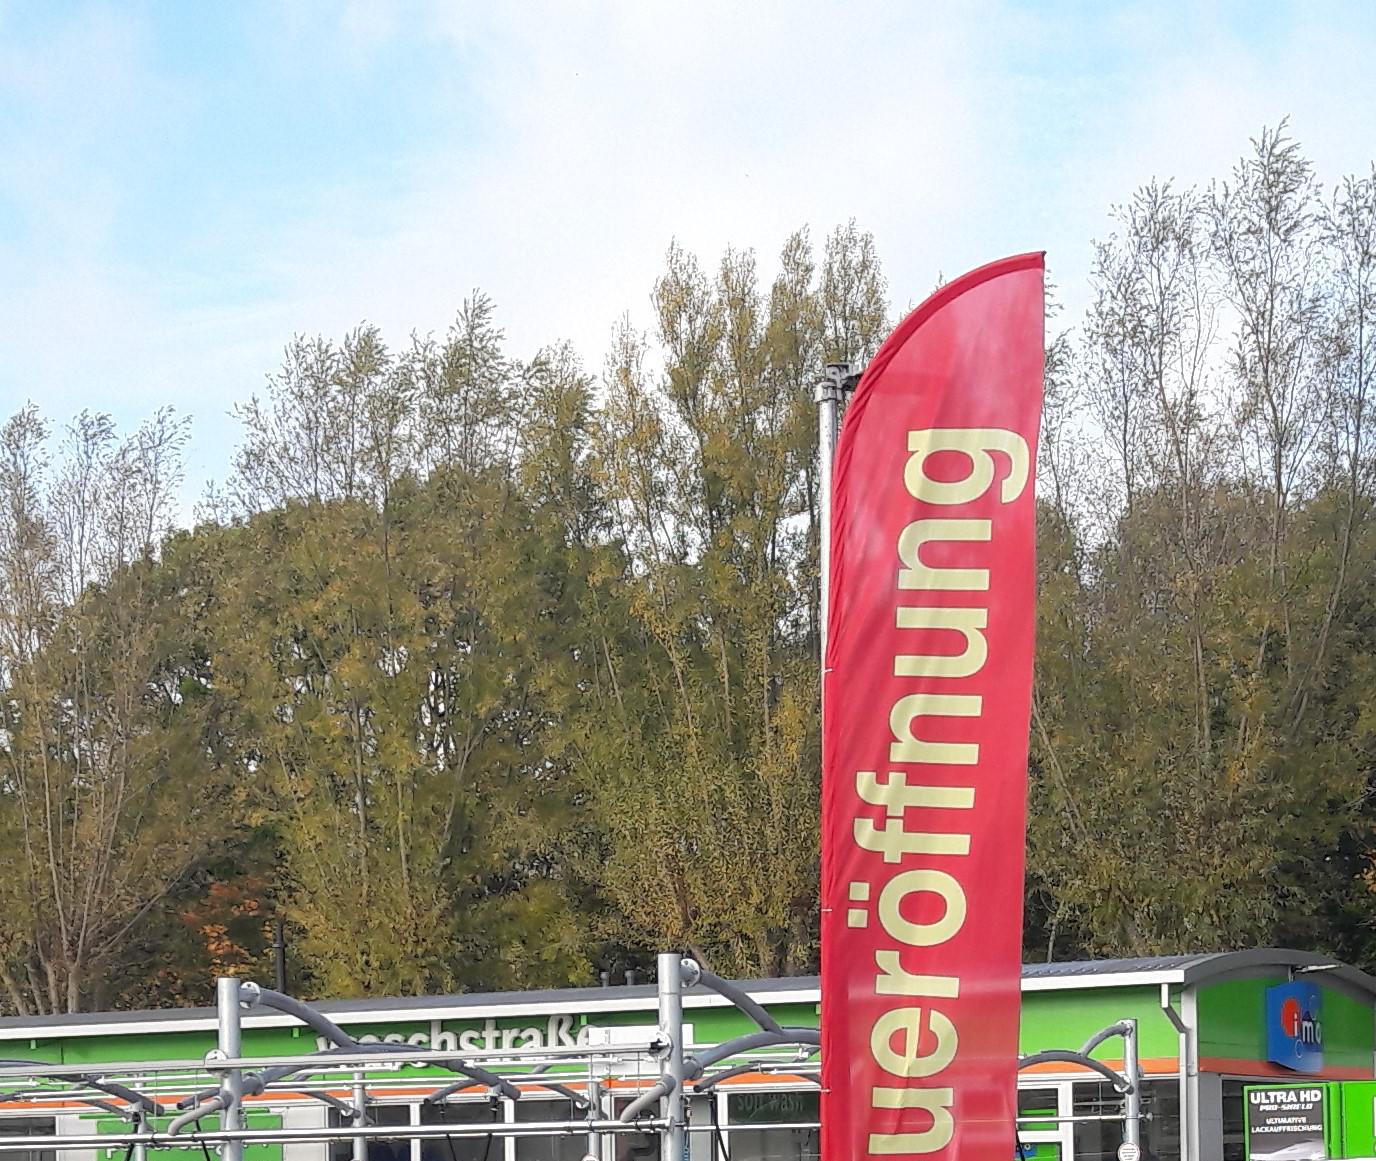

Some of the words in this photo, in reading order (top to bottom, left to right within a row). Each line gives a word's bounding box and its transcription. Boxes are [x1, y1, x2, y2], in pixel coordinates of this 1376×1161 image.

[1293, 1012, 1322, 1044] imo
[1250, 1091, 1297, 1104] ULTRA
[1299, 1090, 1322, 1102] HD
